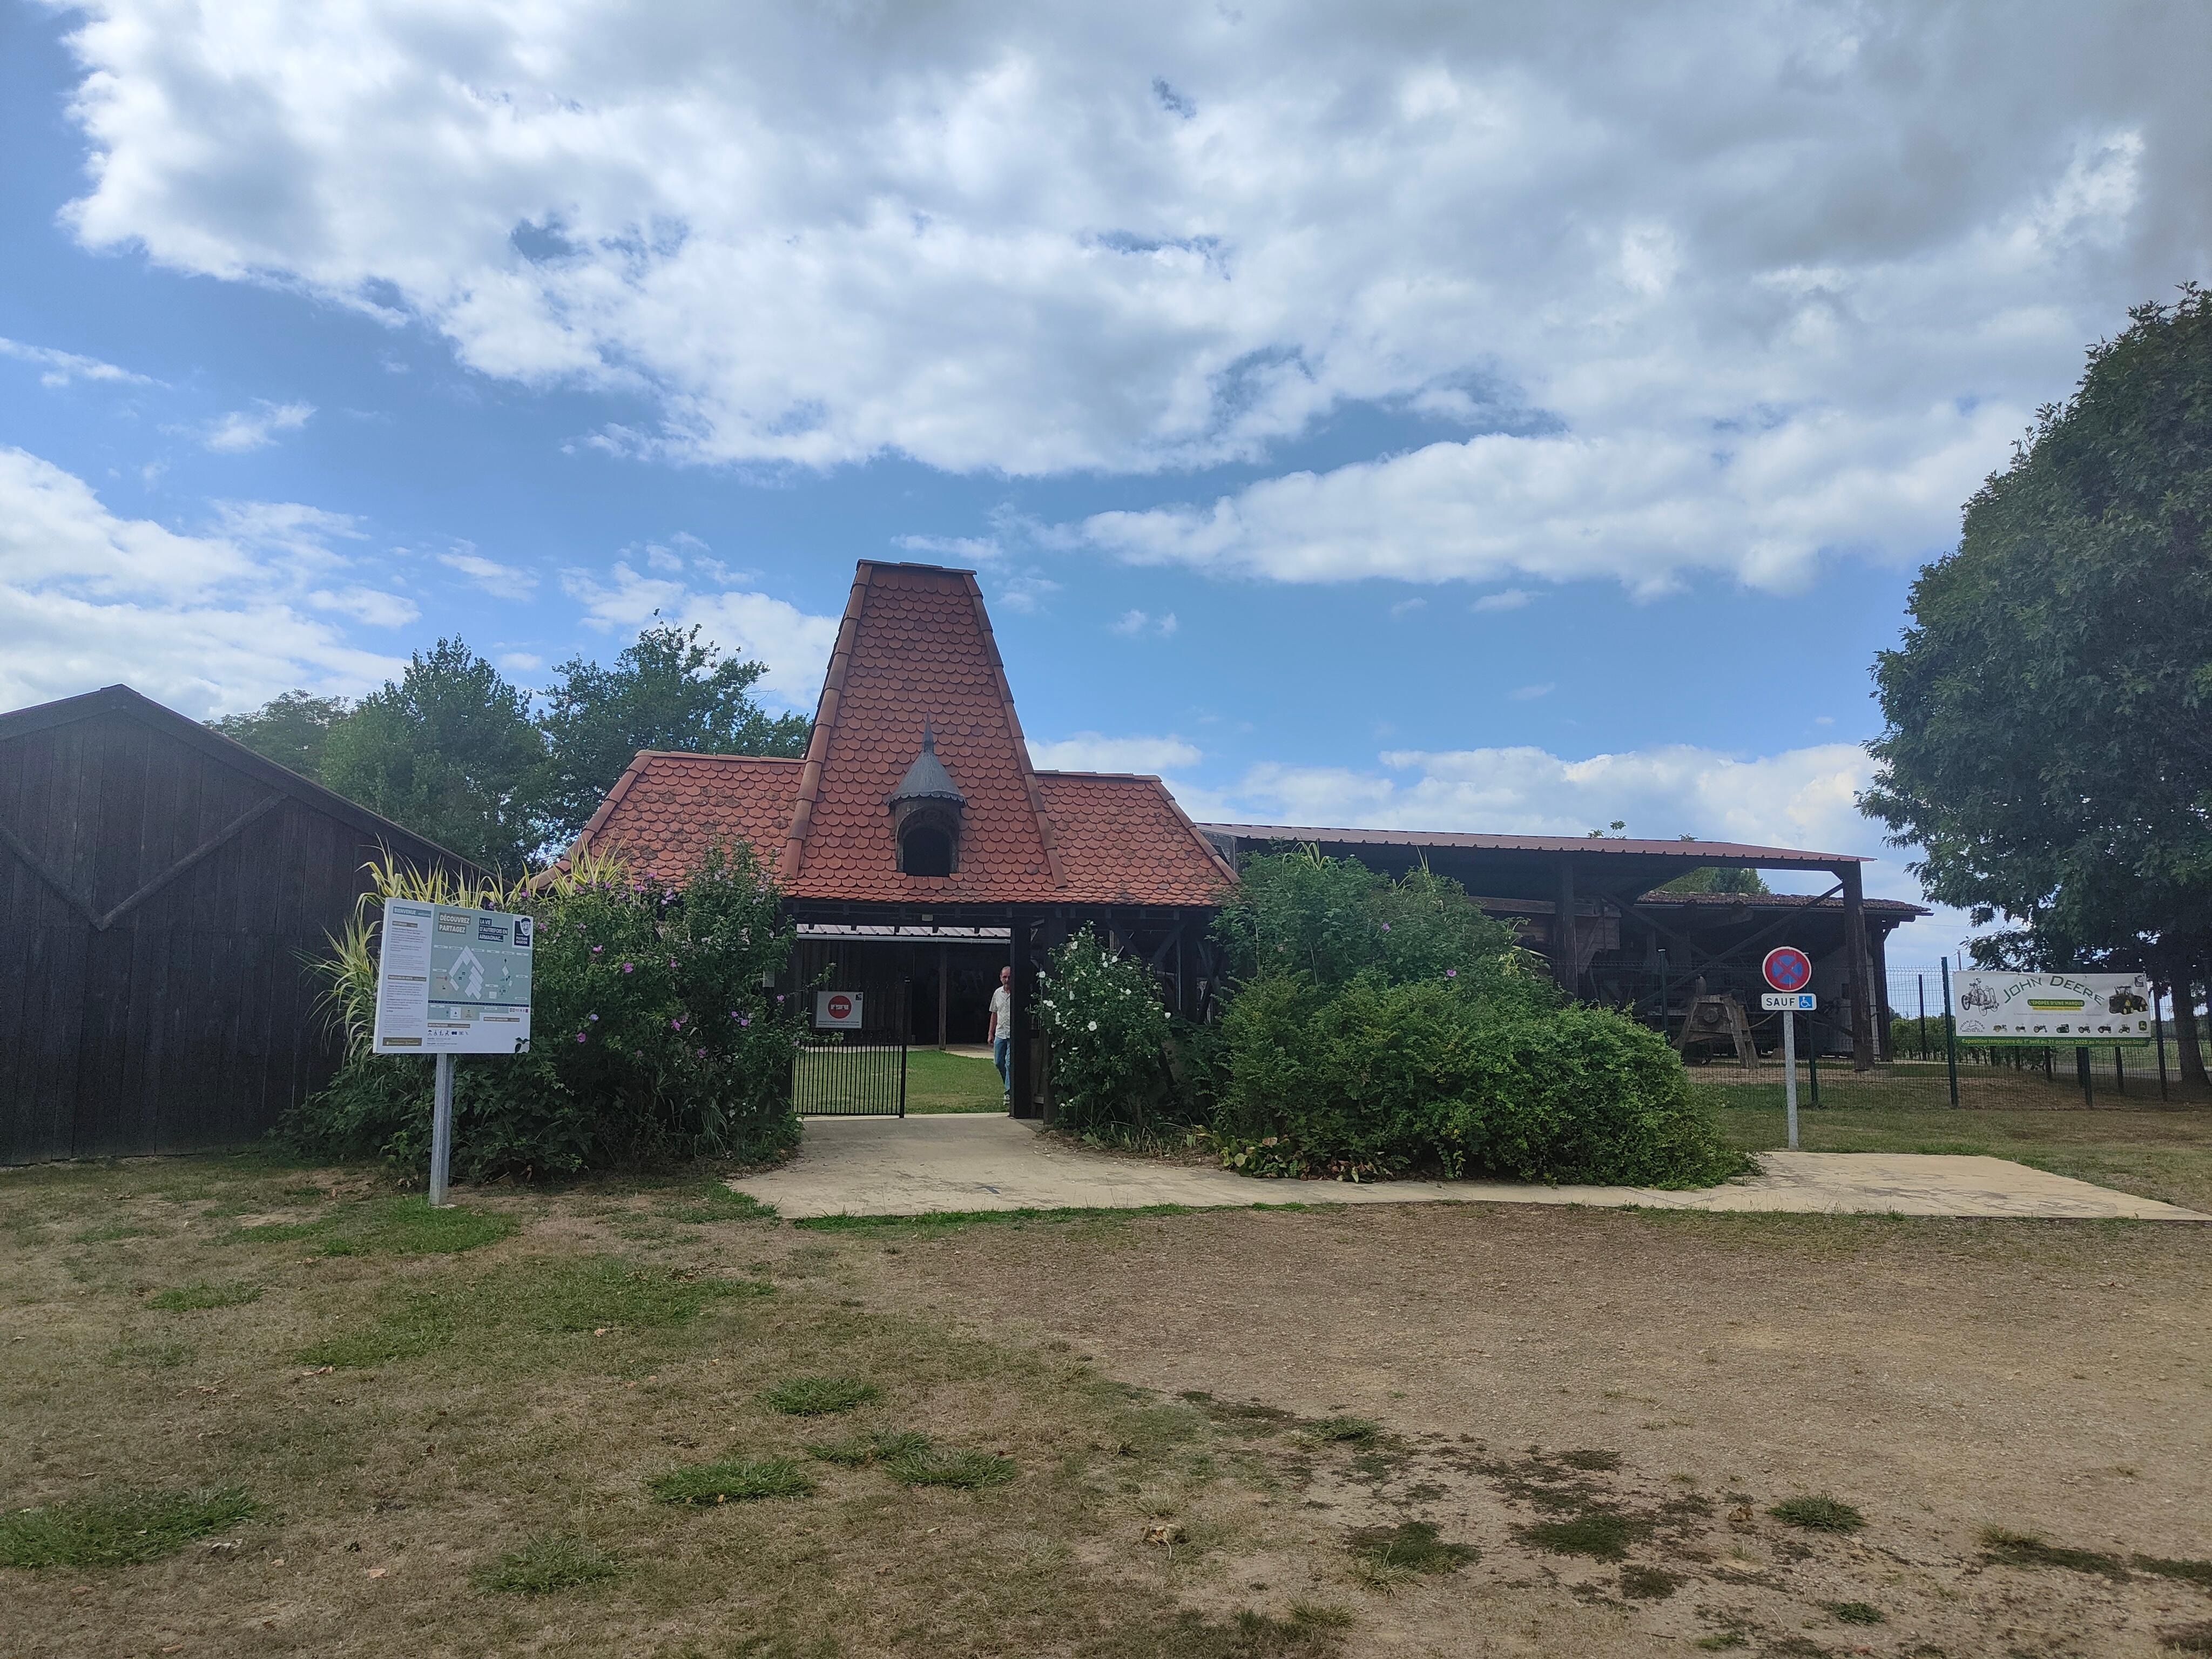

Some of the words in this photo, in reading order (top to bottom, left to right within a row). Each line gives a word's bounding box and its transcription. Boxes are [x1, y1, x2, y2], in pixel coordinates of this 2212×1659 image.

[440, 914, 470, 924] DÉCOUVREZ
[439, 925, 466, 934] PARTAGEZ
[2003, 977, 2042, 1004] JOHN
[2049, 975, 2105, 1006] DEERE
[1766, 997, 1795, 1007] SAUF
